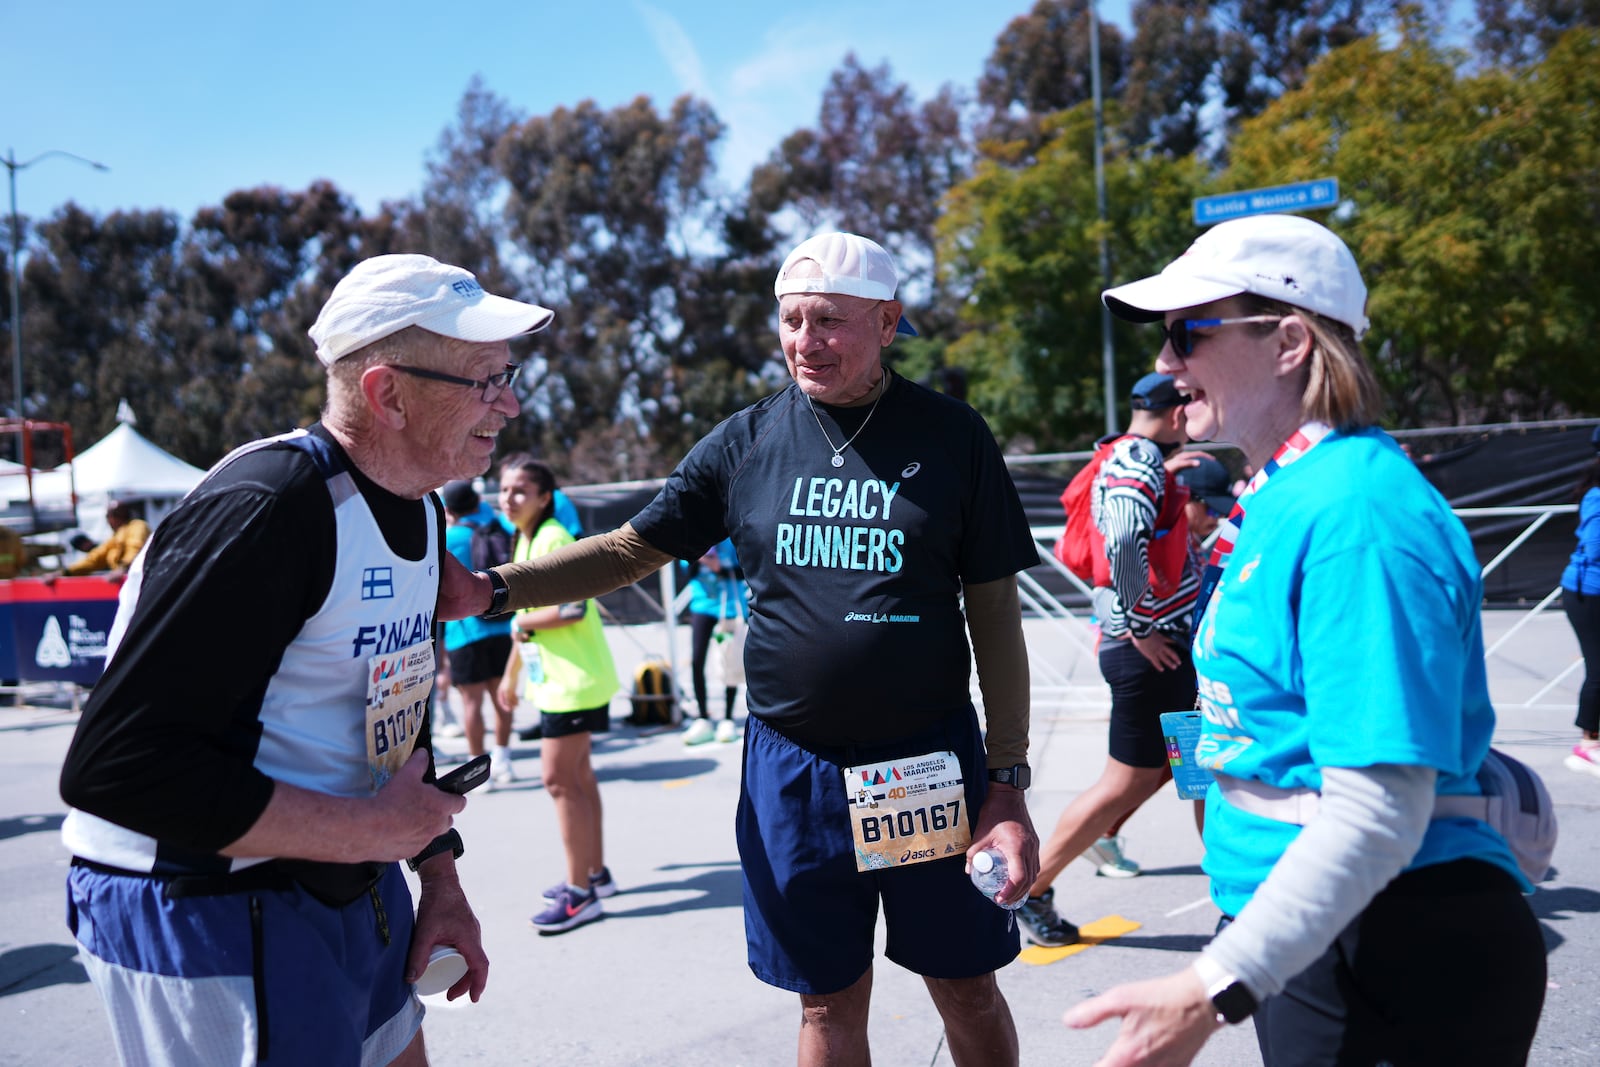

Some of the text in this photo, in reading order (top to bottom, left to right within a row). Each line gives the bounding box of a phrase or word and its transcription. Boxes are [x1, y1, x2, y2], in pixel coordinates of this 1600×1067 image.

[1204, 201, 1247, 216] Santa
[1251, 190, 1308, 209] Monica
[789, 477, 900, 520] LEGACY
[775, 523, 905, 573] RUNNERS
[889, 614, 920, 623] MARATHON
[903, 764, 947, 777] MARATHON
[916, 758, 945, 768] ANGELES
[887, 786, 907, 800] 40
[861, 801, 960, 844] B10167
